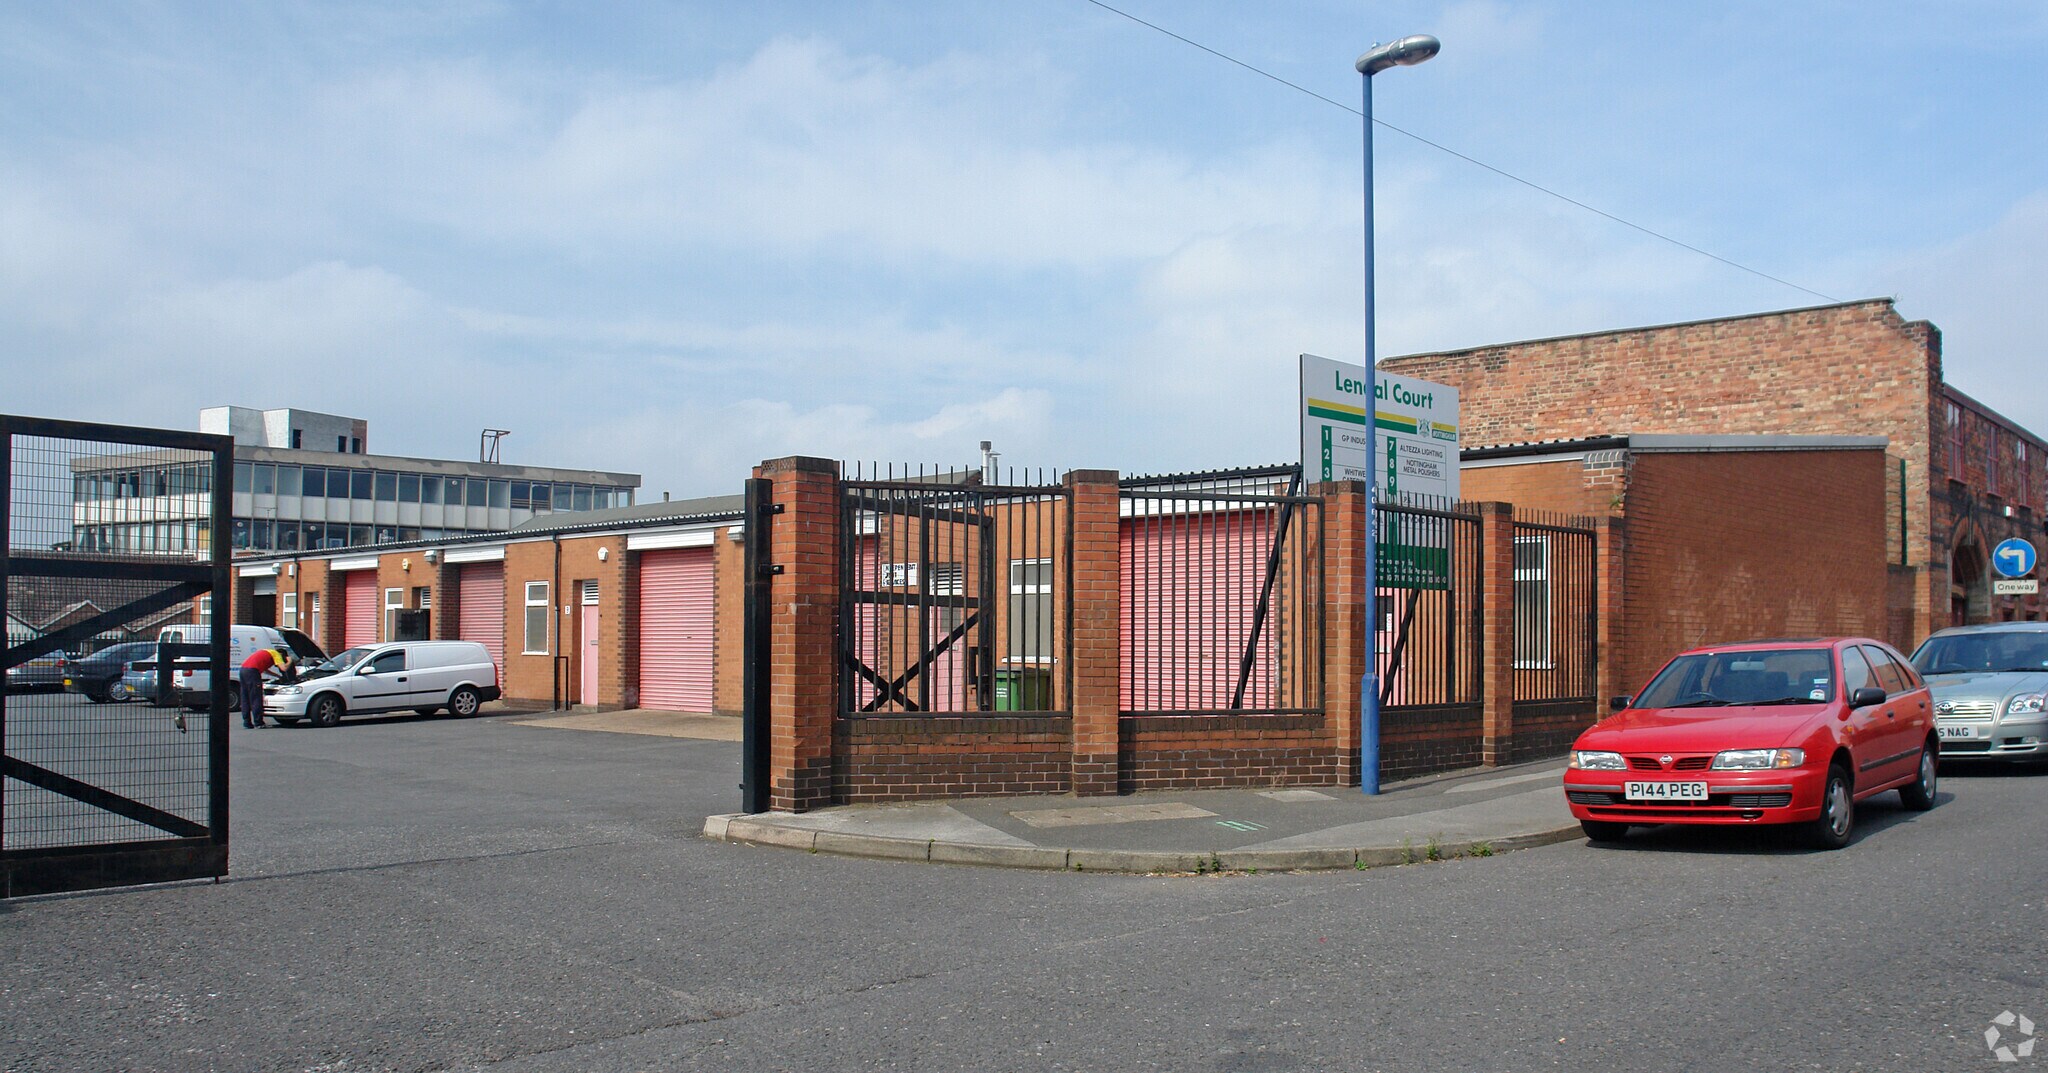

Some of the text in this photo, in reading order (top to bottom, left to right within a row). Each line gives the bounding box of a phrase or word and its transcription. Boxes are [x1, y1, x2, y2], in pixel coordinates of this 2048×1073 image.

[1336, 370, 1433, 409] Lenal Court
[1324, 430, 1329, 440] 1
[1341, 434, 1350, 443] GP
[1389, 441, 1394, 451] 7
[1324, 449, 1330, 459] 2
[1400, 445, 1443, 459] ALTEZZA LIGHTING
[1389, 459, 1395, 469] 8
[1406, 459, 1437, 470] NOTTINGHAM
[1324, 467, 1330, 478] 3
[1344, 468, 1366, 478] WHITWE
[1403, 466, 1417, 475] METAL
[1389, 476, 1395, 487] 9
[2017, 583, 2035, 591] way
[1947, 727, 1969, 737] NAG
[1630, 783, 1702, 797] P144 PEG
